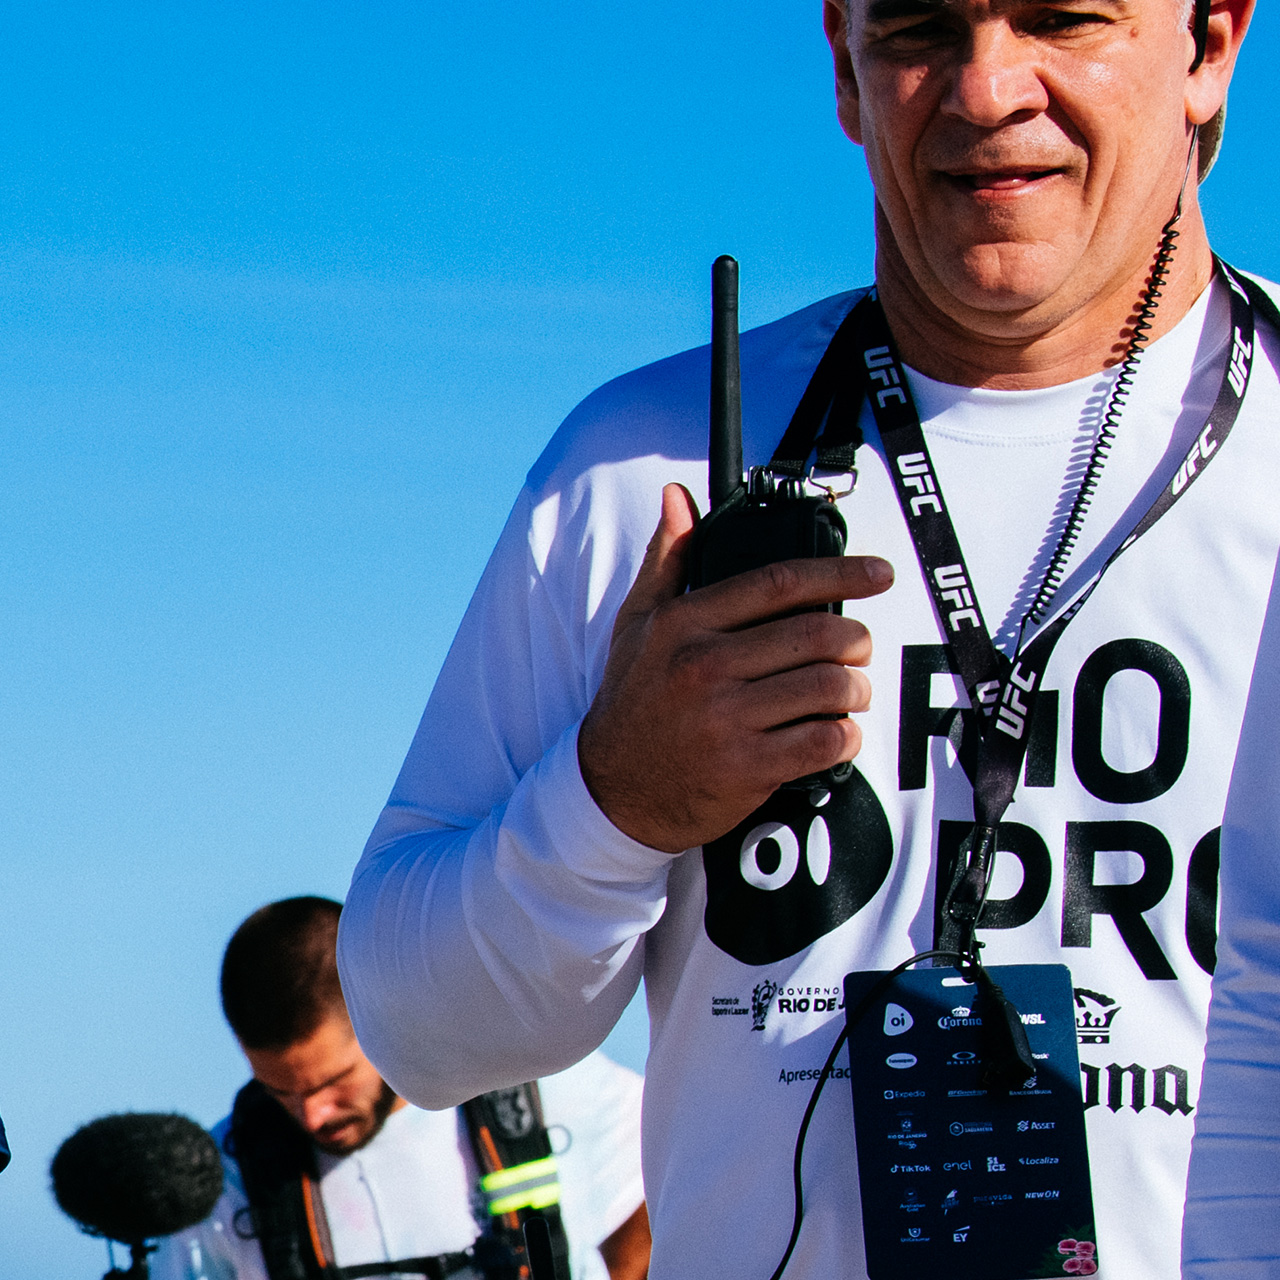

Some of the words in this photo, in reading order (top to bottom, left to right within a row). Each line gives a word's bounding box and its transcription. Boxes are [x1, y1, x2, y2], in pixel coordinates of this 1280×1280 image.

[1228, 326, 1252, 398] UFC
[864, 346, 907, 409] UFC
[1171, 424, 1217, 495] UFC
[897, 452, 942, 516] UFC
[934, 565, 979, 632] UFC
[995, 661, 1036, 740] UFC
[740, 788, 831, 890] oi
[778, 987, 840, 996] GOVERNO
[778, 998, 810, 1013] RIO
[813, 998, 837, 1012] DE
[891, 1013, 906, 1026] oi
[937, 1016, 983, 1030] Corona
[895, 1090, 926, 1098] Expedia
[1031, 1122, 1056, 1130] ASSET
[943, 1160, 972, 1171] enel
[987, 1163, 1006, 1172] ICE
[1025, 1157, 1059, 1165] Localiza
[901, 1164, 931, 1173] TikTok
[953, 1233, 968, 1242] EY
